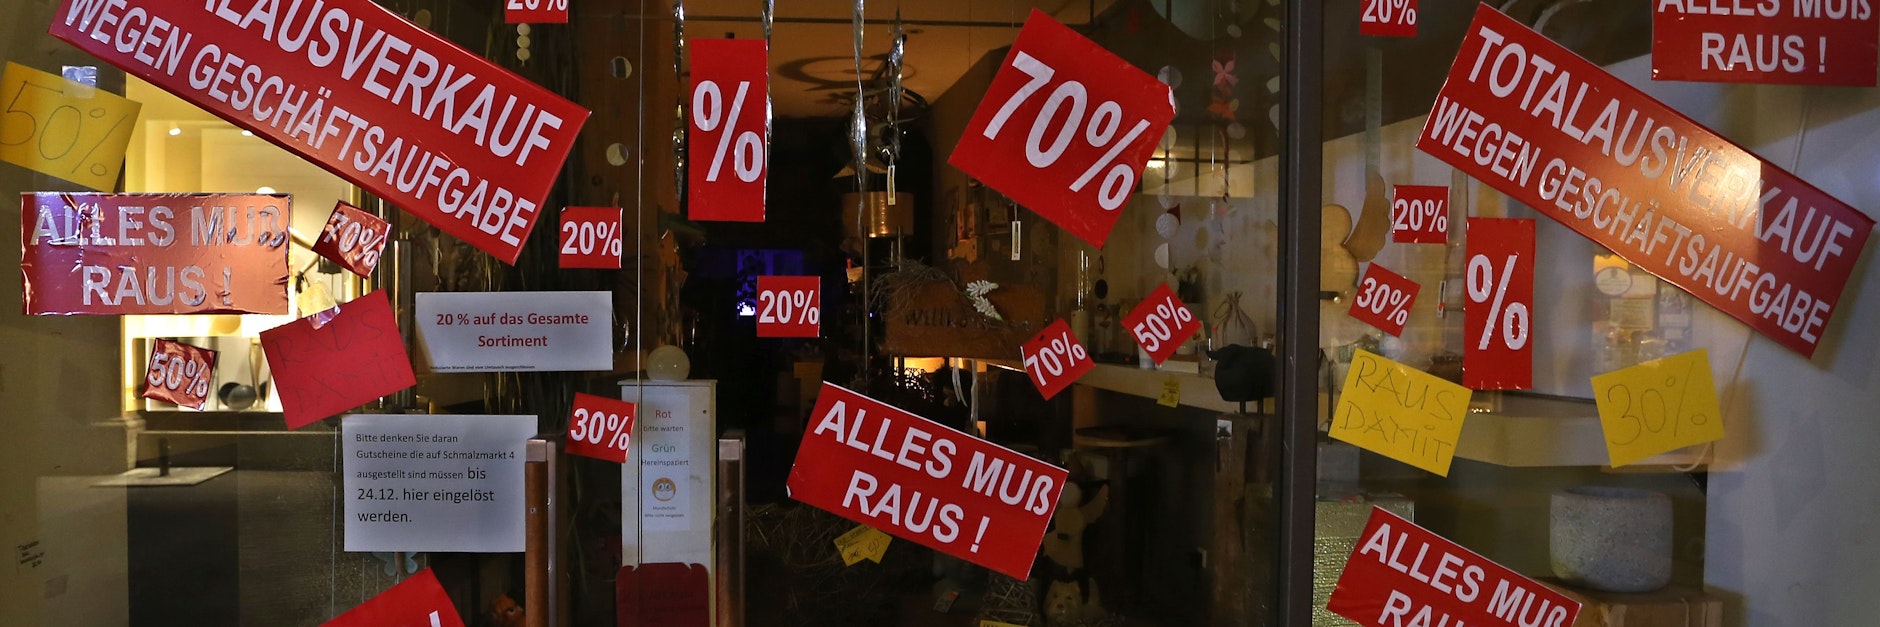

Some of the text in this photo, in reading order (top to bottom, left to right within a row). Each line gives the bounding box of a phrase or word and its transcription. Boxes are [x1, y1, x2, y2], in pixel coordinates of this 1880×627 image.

[1361, 0, 1416, 25] 20%
[1701, 32, 1827, 73] RAUS !
[204, 0, 563, 167] LAUSVERKAUF
[0, 80, 128, 176] 50%
[65, 0, 537, 247] WEGEN GESCHÄFTSAUFGABE
[693, 81, 764, 183] %
[983, 51, 1151, 211] 70%
[1468, 26, 1853, 271] TOTALAUSVERKAUF
[30, 203, 285, 247] ALLES MUß
[1393, 199, 1447, 233] 20%
[1429, 96, 1830, 345] WEGEN GESCHÄFTSAUFGABE
[323, 211, 385, 268] 70%
[561, 221, 622, 258] 20%
[82, 265, 233, 306] RAUS !
[759, 290, 819, 325] 20%
[1357, 277, 1411, 326] 30%
[1467, 254, 1529, 350] %
[436, 312, 589, 326] 20 % auf das Gesamte
[478, 335, 548, 347] Sortiment
[1133, 296, 1192, 352] 50%
[147, 351, 208, 399] 50%
[1025, 331, 1087, 386] 70%
[1355, 355, 1455, 421] RAUS
[1608, 359, 1708, 446] 30%
[570, 408, 631, 450] 30%
[655, 409, 672, 419] Rot
[356, 433, 458, 443] Bitte denken Sie daran
[356, 450, 515, 460] Gutscheine die auf Schmalzmarkt 4
[651, 444, 676, 453] Grün
[814, 400, 1054, 516] ALLES MUß
[356, 467, 486, 480] ausgestellt sind müssen bis
[642, 459, 689, 467] Hereinspaziert
[357, 488, 495, 504] 24.12. hier eingelöst
[357, 510, 413, 523] werden.
[841, 470, 990, 553] RAUS !
[1360, 522, 1568, 627] ALLES MUß
